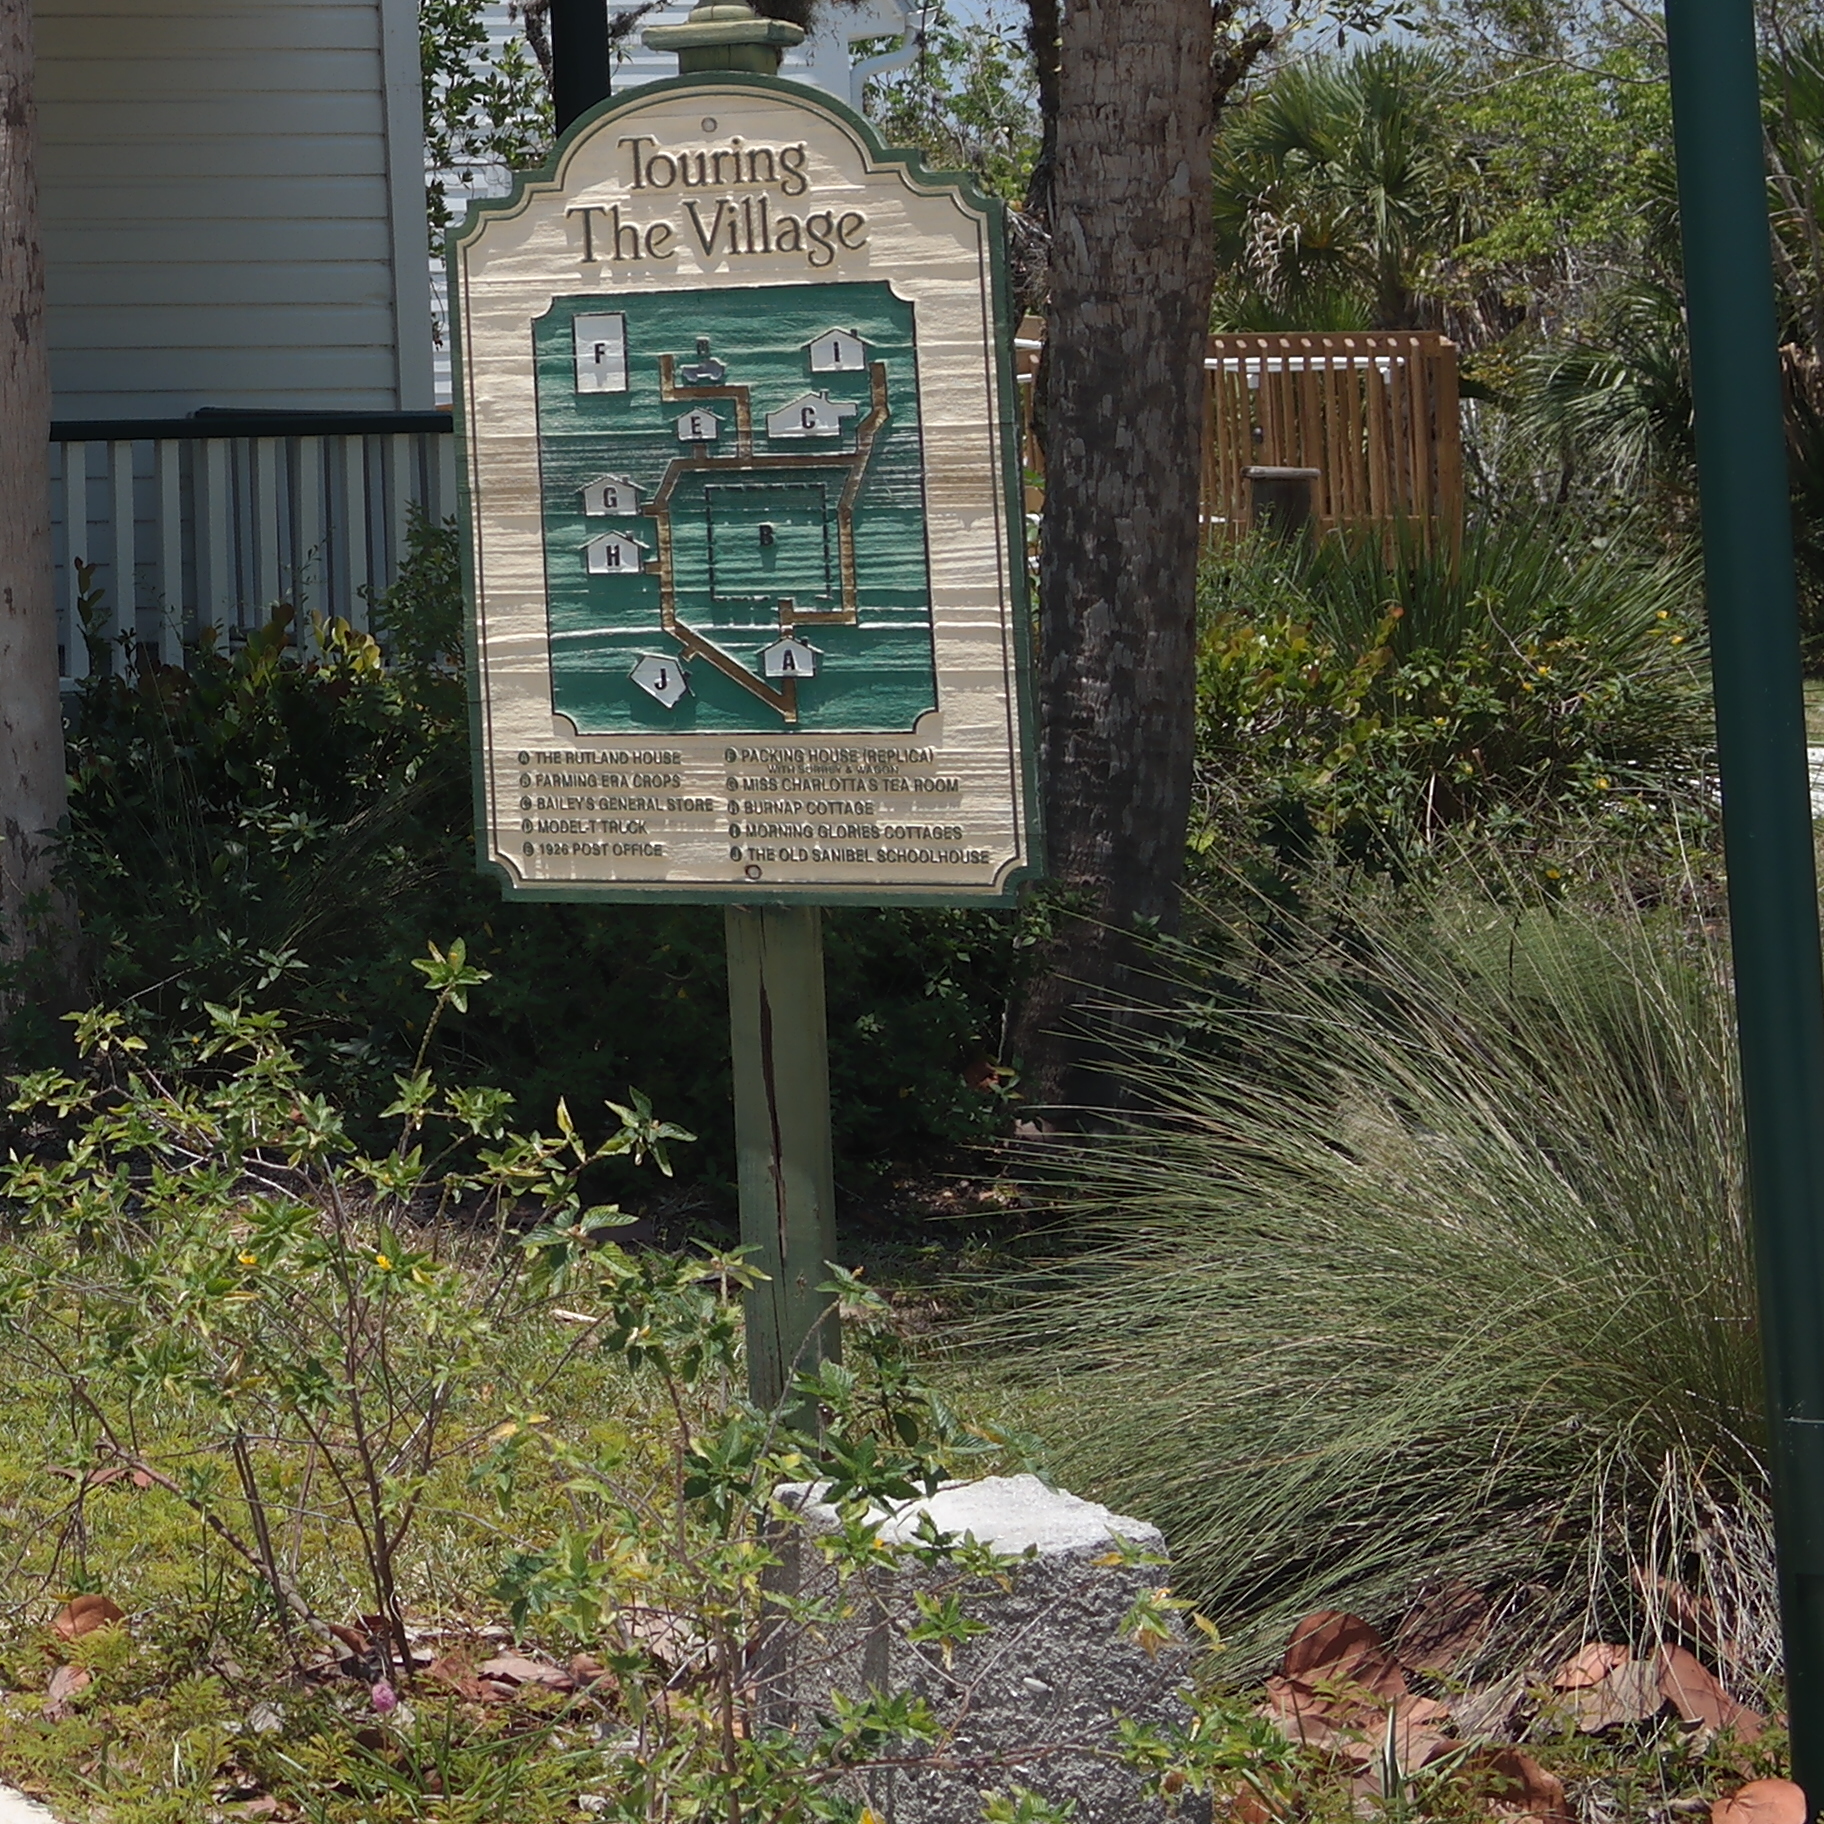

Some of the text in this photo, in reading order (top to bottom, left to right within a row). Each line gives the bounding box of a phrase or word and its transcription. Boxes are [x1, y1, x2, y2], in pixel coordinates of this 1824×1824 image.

[616, 135, 808, 197] Touring
[565, 195, 869, 268] The Village
[594, 343, 606, 364] F
[691, 416, 702, 434] E
[800, 407, 816, 429] C
[603, 487, 618, 508] G
[758, 524, 774, 546] B
[606, 545, 620, 567] H
[782, 649, 796, 671] A
[654, 668, 668, 691] J
[535, 750, 561, 765] THE
[565, 750, 629, 765] RUTLAND
[632, 750, 682, 765] HOUSE
[741, 748, 804, 764] PACKING
[808, 748, 858, 764] HOUSE
[862, 747, 935, 764] (REPLICA)
[767, 764, 795, 774] WITH
[856, 764, 900, 774] WAGON
[535, 774, 598, 789] FARMING
[601, 774, 628, 788] ERA
[632, 773, 682, 789] CROPS
[743, 777, 778, 792] MISS
[882, 778, 910, 792] TEA
[914, 778, 959, 792] ROOM
[598, 797, 665, 811] GENERAL
[667, 797, 714, 812] STORE
[744, 801, 802, 814] BURNAP
[806, 801, 874, 815] COTTAGE
[537, 819, 598, 834] MODEL-T
[601, 819, 648, 834] TRUCK
[745, 824, 814, 839] MORNING
[817, 824, 881, 839] GLORIES
[884, 825, 963, 840] COTTAGES
[539, 843, 569, 856] 1926
[572, 843, 609, 856] POST
[612, 843, 663, 857] OFFICE
[748, 847, 775, 862] THE
[779, 848, 808, 862] OLD
[812, 849, 873, 863] SANIBEL
[877, 849, 990, 864] SCHOOLHOUSE
